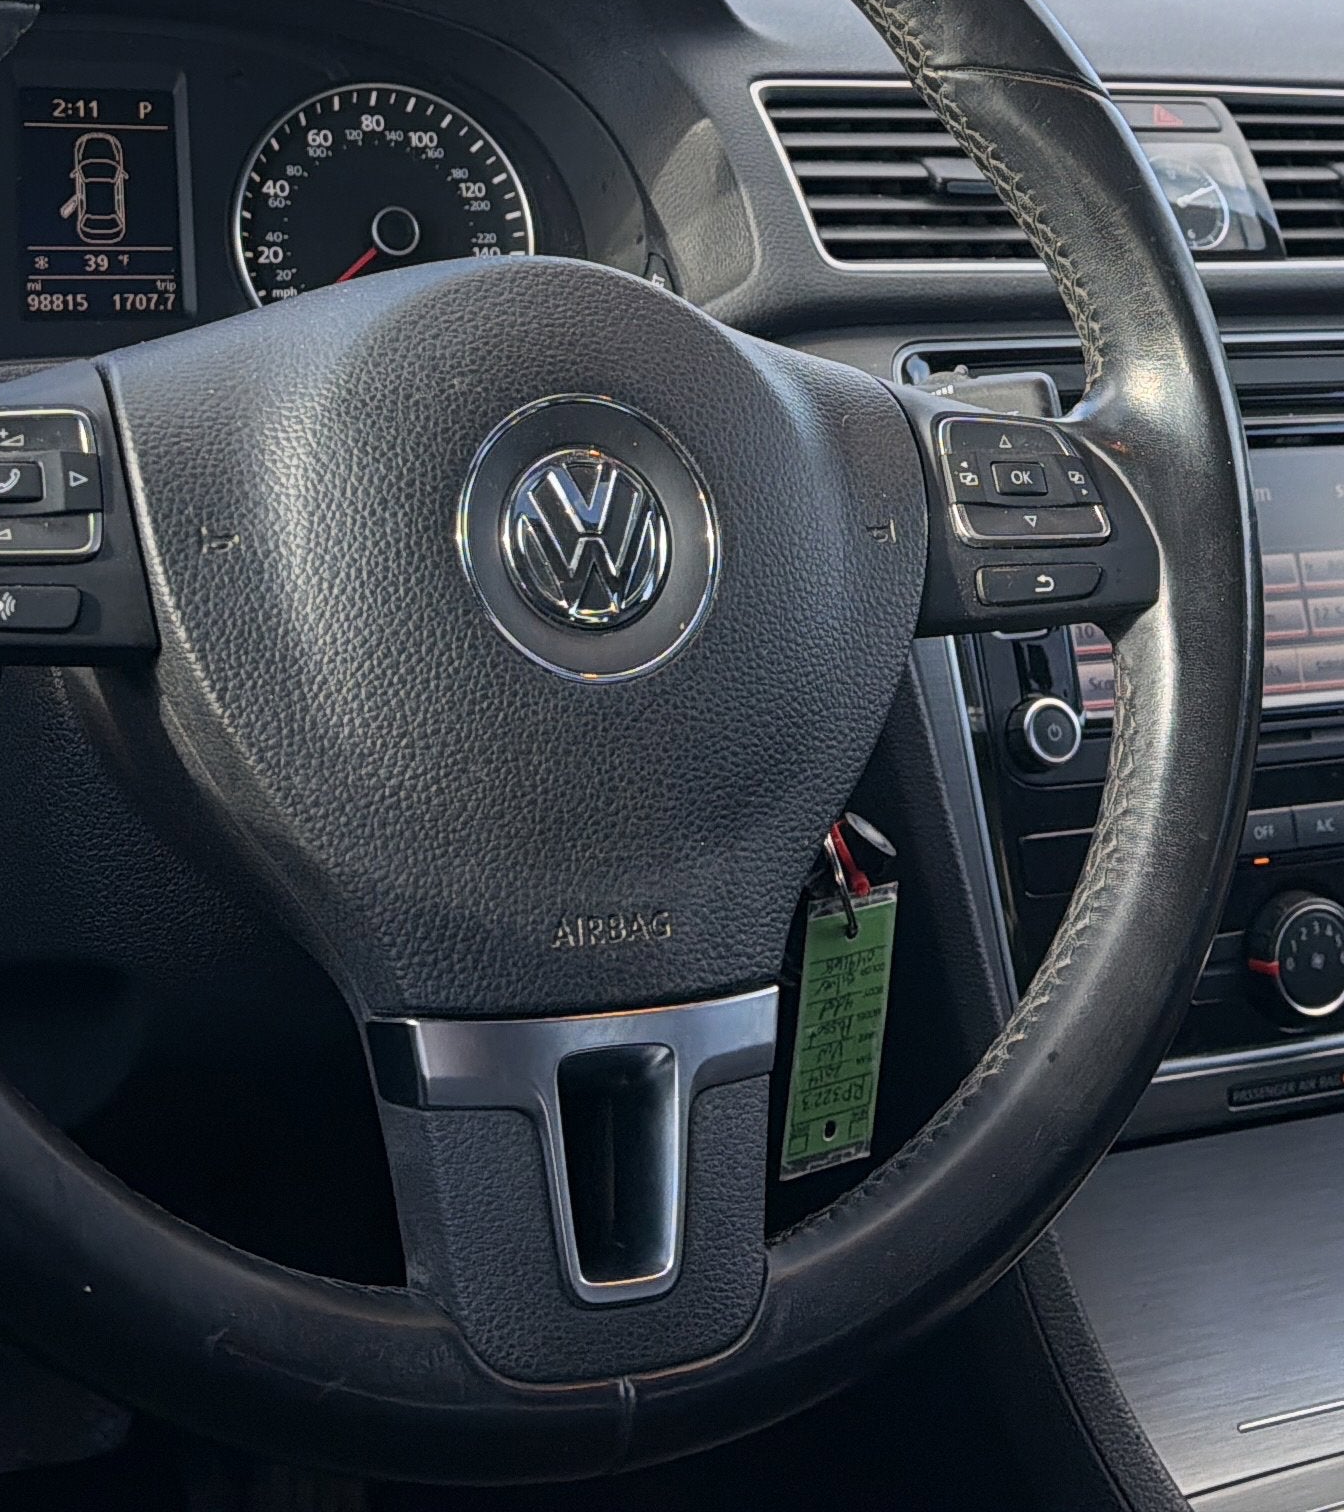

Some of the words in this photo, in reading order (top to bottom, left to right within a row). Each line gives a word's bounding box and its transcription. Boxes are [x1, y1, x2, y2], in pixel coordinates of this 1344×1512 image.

[52, 98, 99, 118] 2:11
[138, 101, 153, 120] P
[360, 114, 385, 132] 80
[307, 129, 333, 147] 60
[345, 129, 363, 141] 120
[385, 130, 404, 141] 140
[407, 131, 438, 148] 100
[306, 147, 327, 158] 100
[425, 148, 444, 159] 160
[286, 164, 302, 177] 80
[450, 168, 469, 179] 180
[262, 179, 289, 197] 40
[459, 182, 486, 198] 120
[268, 197, 285, 209] 60
[469, 200, 491, 212] 200
[265, 231, 283, 242] 40
[476, 232, 497, 244] 220
[257, 246, 283, 264] 20
[83, 254, 109, 272] 39
[275, 269, 292, 281] 20
[27, 280, 42, 291] mi
[156, 279, 177, 292] trip
[272, 287, 298, 300] mph
[27, 294, 89, 312] 98815
[112, 294, 176, 311] 1707.7
[1010, 469, 1034, 485] OK
[1254, 824, 1274, 839] OFF
[552, 911, 672, 949] AIRBAG
[801, 1076, 865, 1111] RP3223
